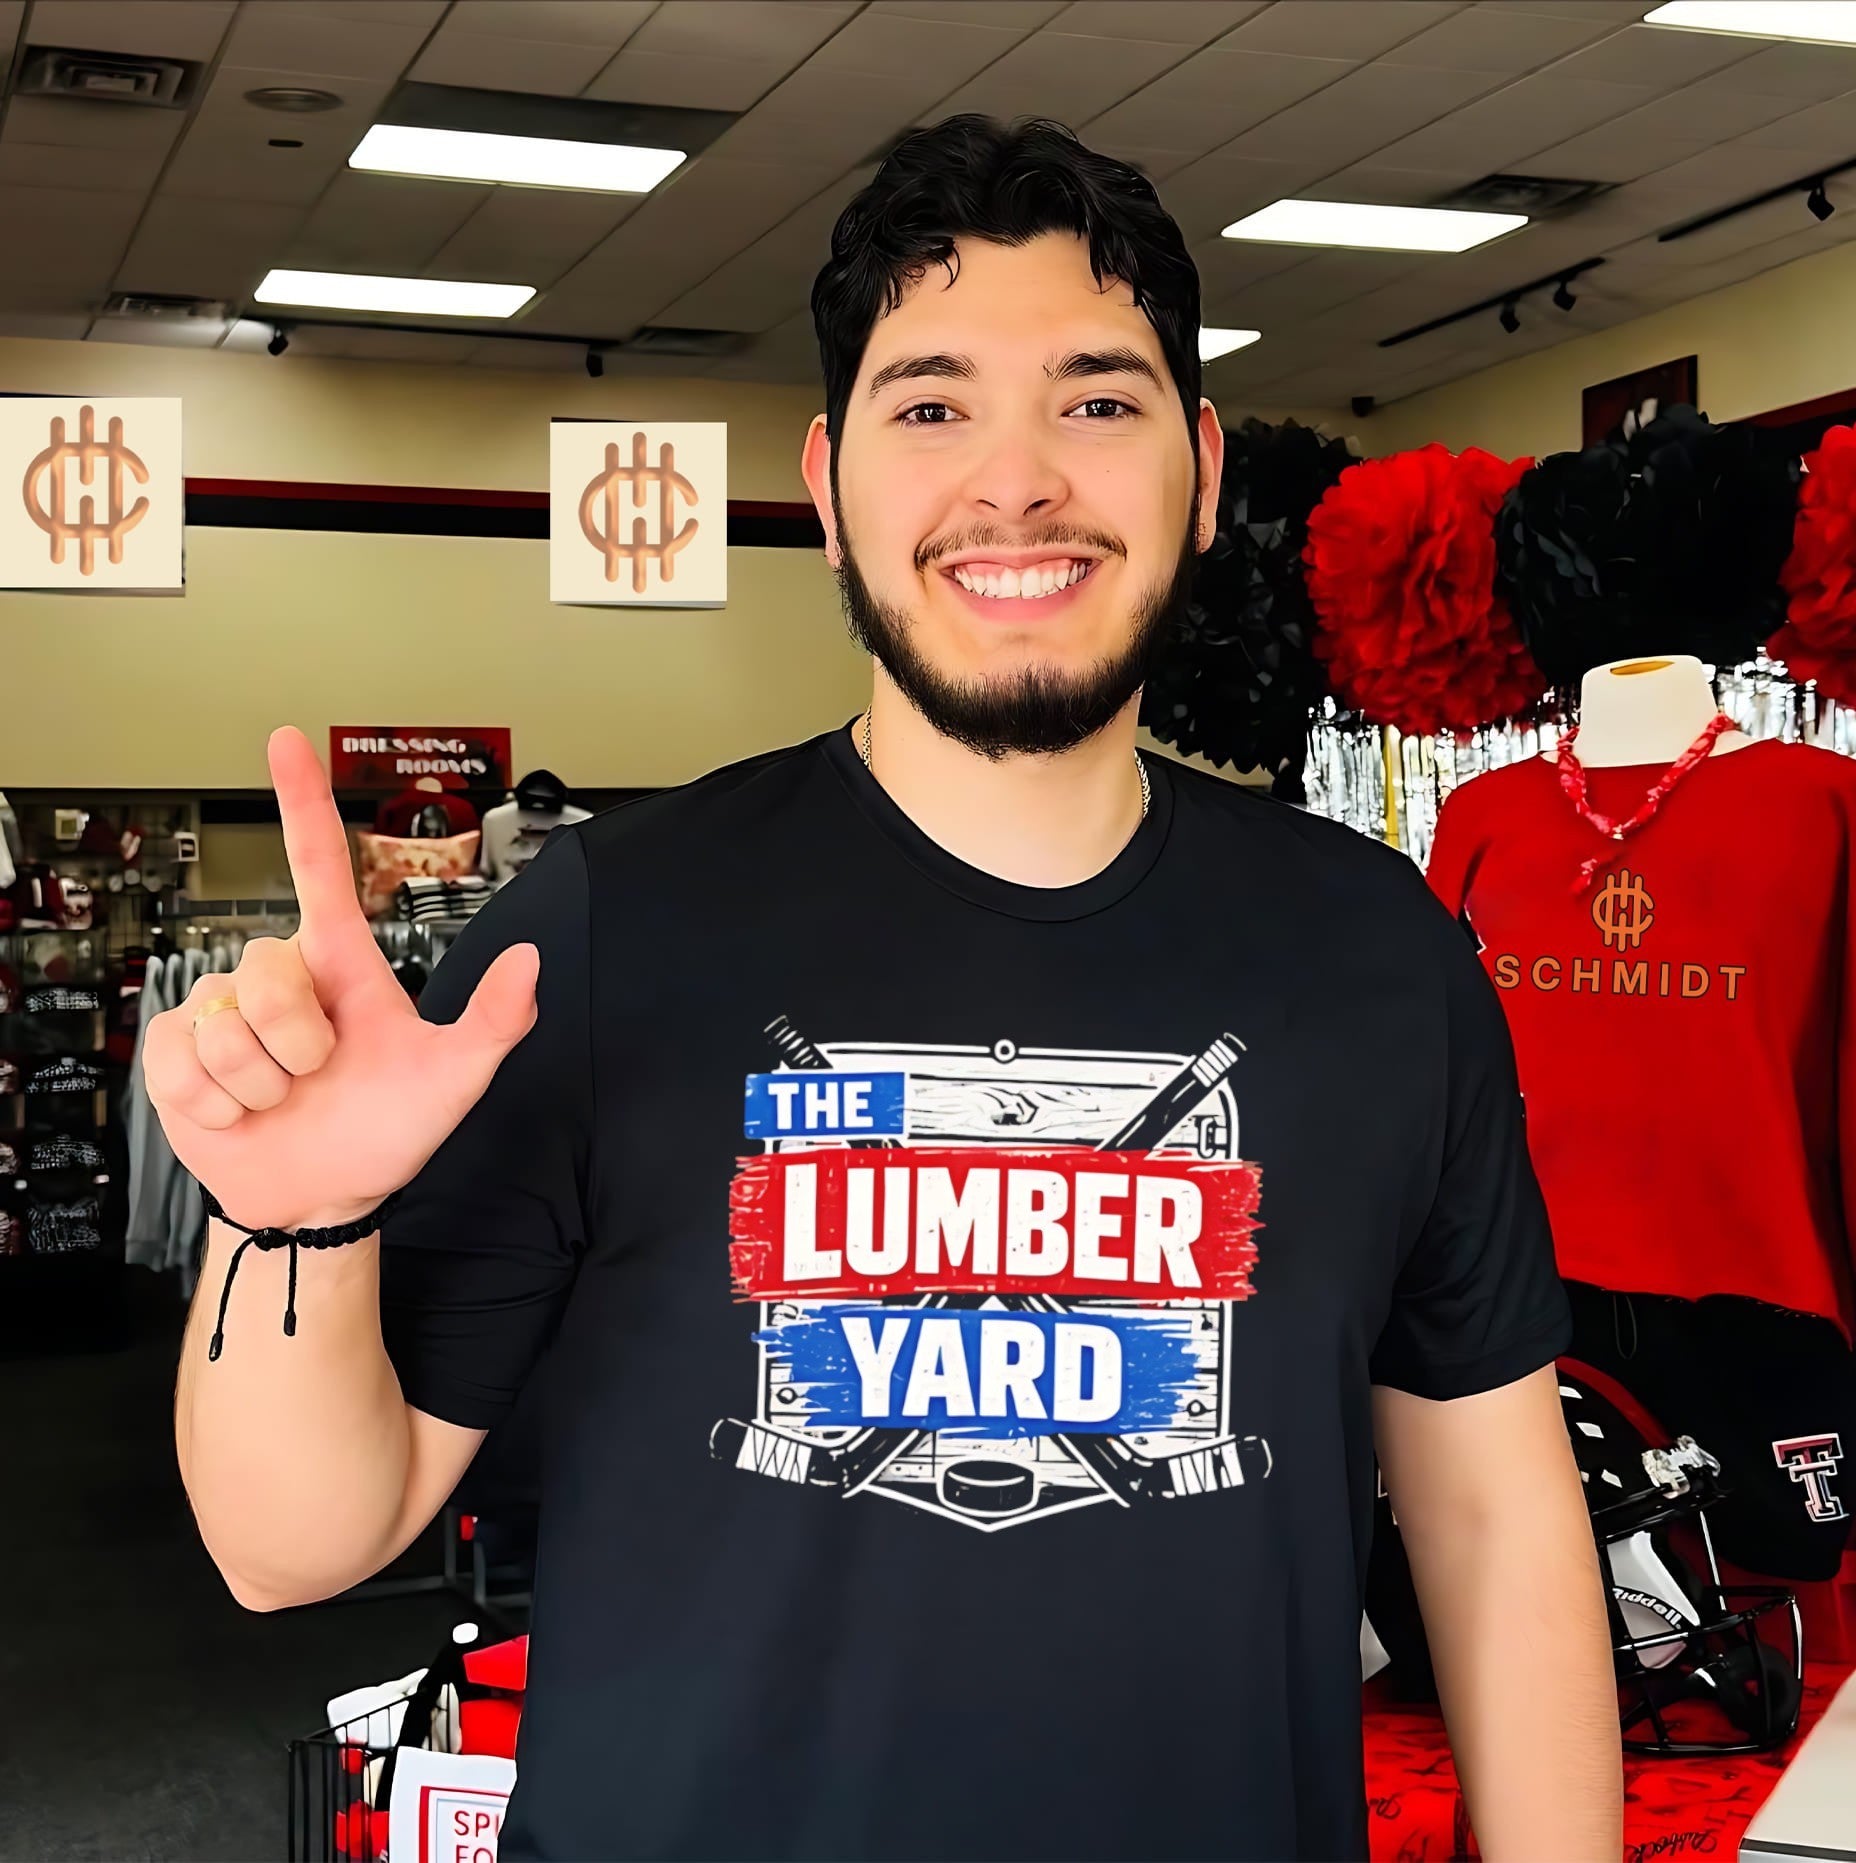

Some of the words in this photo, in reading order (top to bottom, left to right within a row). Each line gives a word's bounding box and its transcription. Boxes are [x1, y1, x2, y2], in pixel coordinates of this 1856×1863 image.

[1494, 954, 1746, 1000] SCHMIDT
[768, 1080, 873, 1130] THE
[783, 1163, 1204, 1288] LUMBER
[840, 1316, 1123, 1423] YARD
